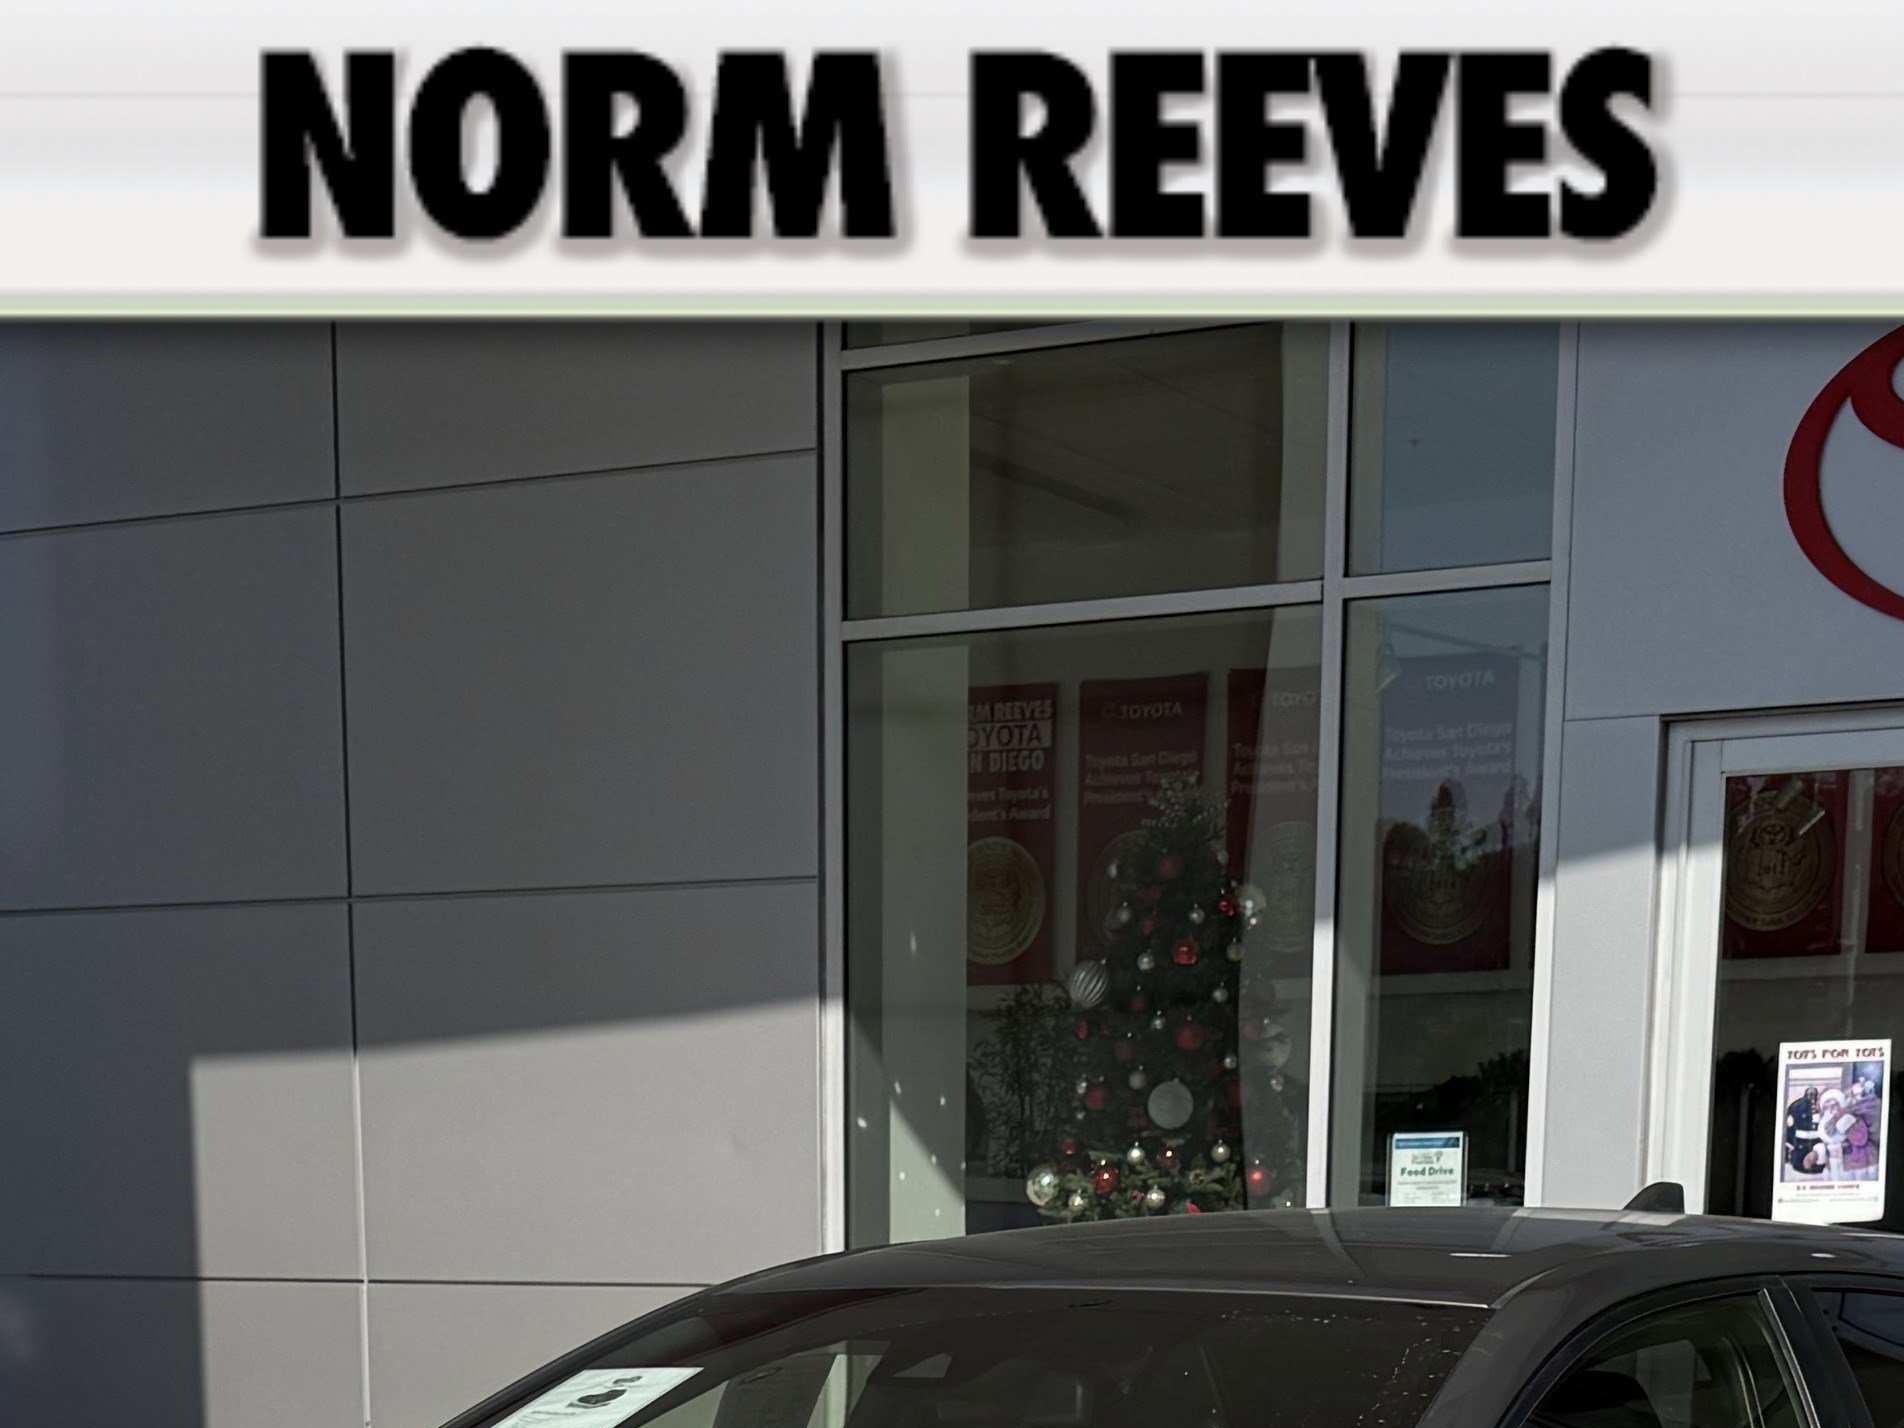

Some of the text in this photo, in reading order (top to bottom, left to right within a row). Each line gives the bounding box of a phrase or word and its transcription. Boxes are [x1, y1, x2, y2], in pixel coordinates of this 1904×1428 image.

[1425, 670, 1496, 692] TOYOTA
[1120, 701, 1184, 719] TOYOTA
[968, 723, 1042, 748] OYOTA
[1428, 1166, 1454, 1177] Drive
